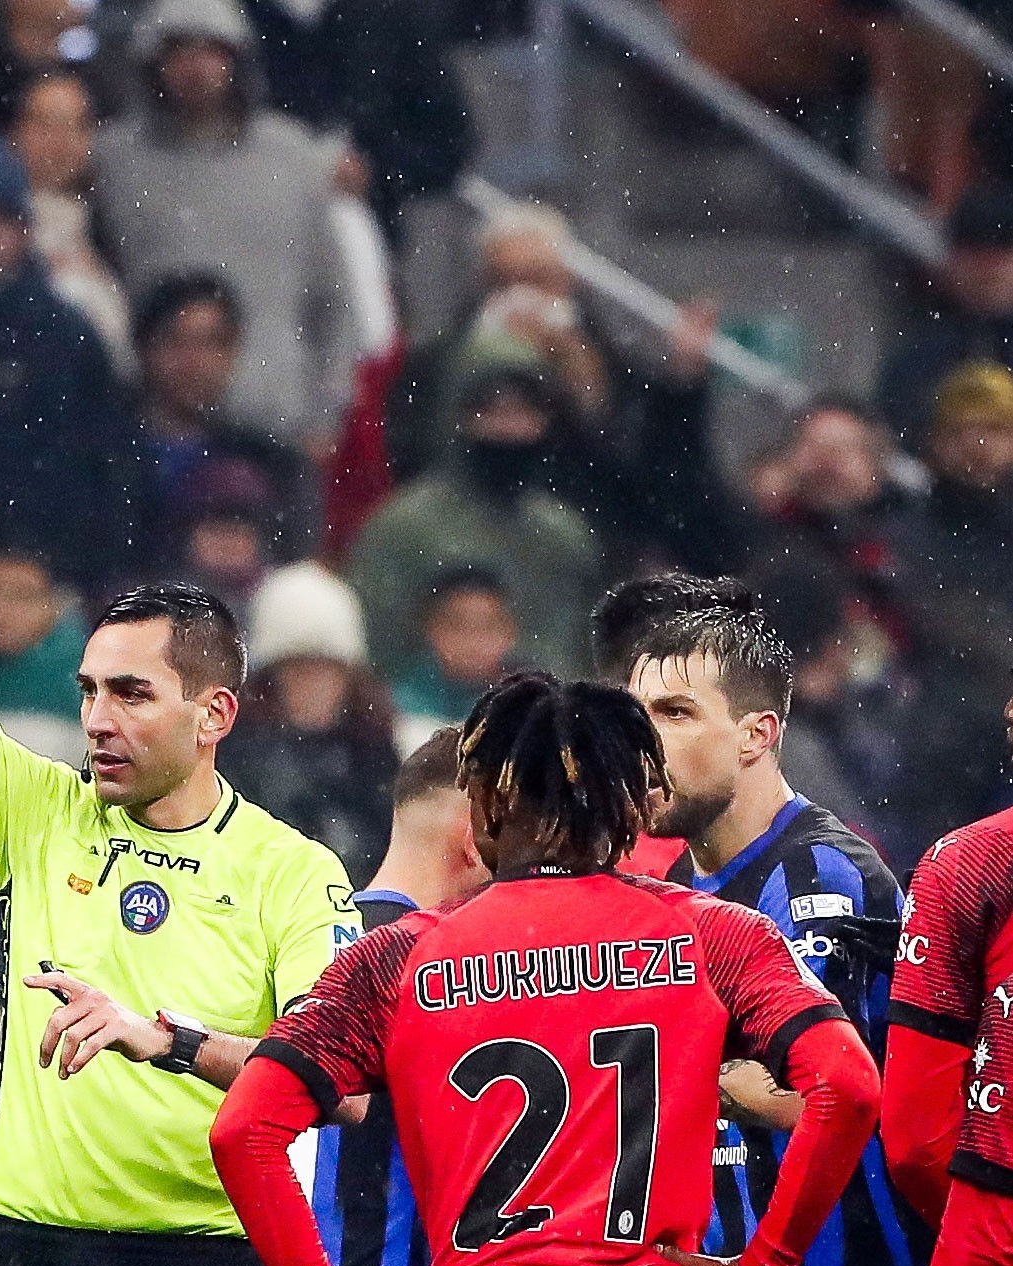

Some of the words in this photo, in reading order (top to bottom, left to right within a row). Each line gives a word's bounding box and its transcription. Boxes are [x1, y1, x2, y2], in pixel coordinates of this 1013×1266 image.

[108, 837, 201, 875] GIVOVA
[540, 865, 572, 875] MILA
[125, 893, 158, 917] AIA
[893, 932, 930, 965] SC
[414, 934, 697, 1012] CHUKWUEZE
[448, 1023, 661, 1252] 21
